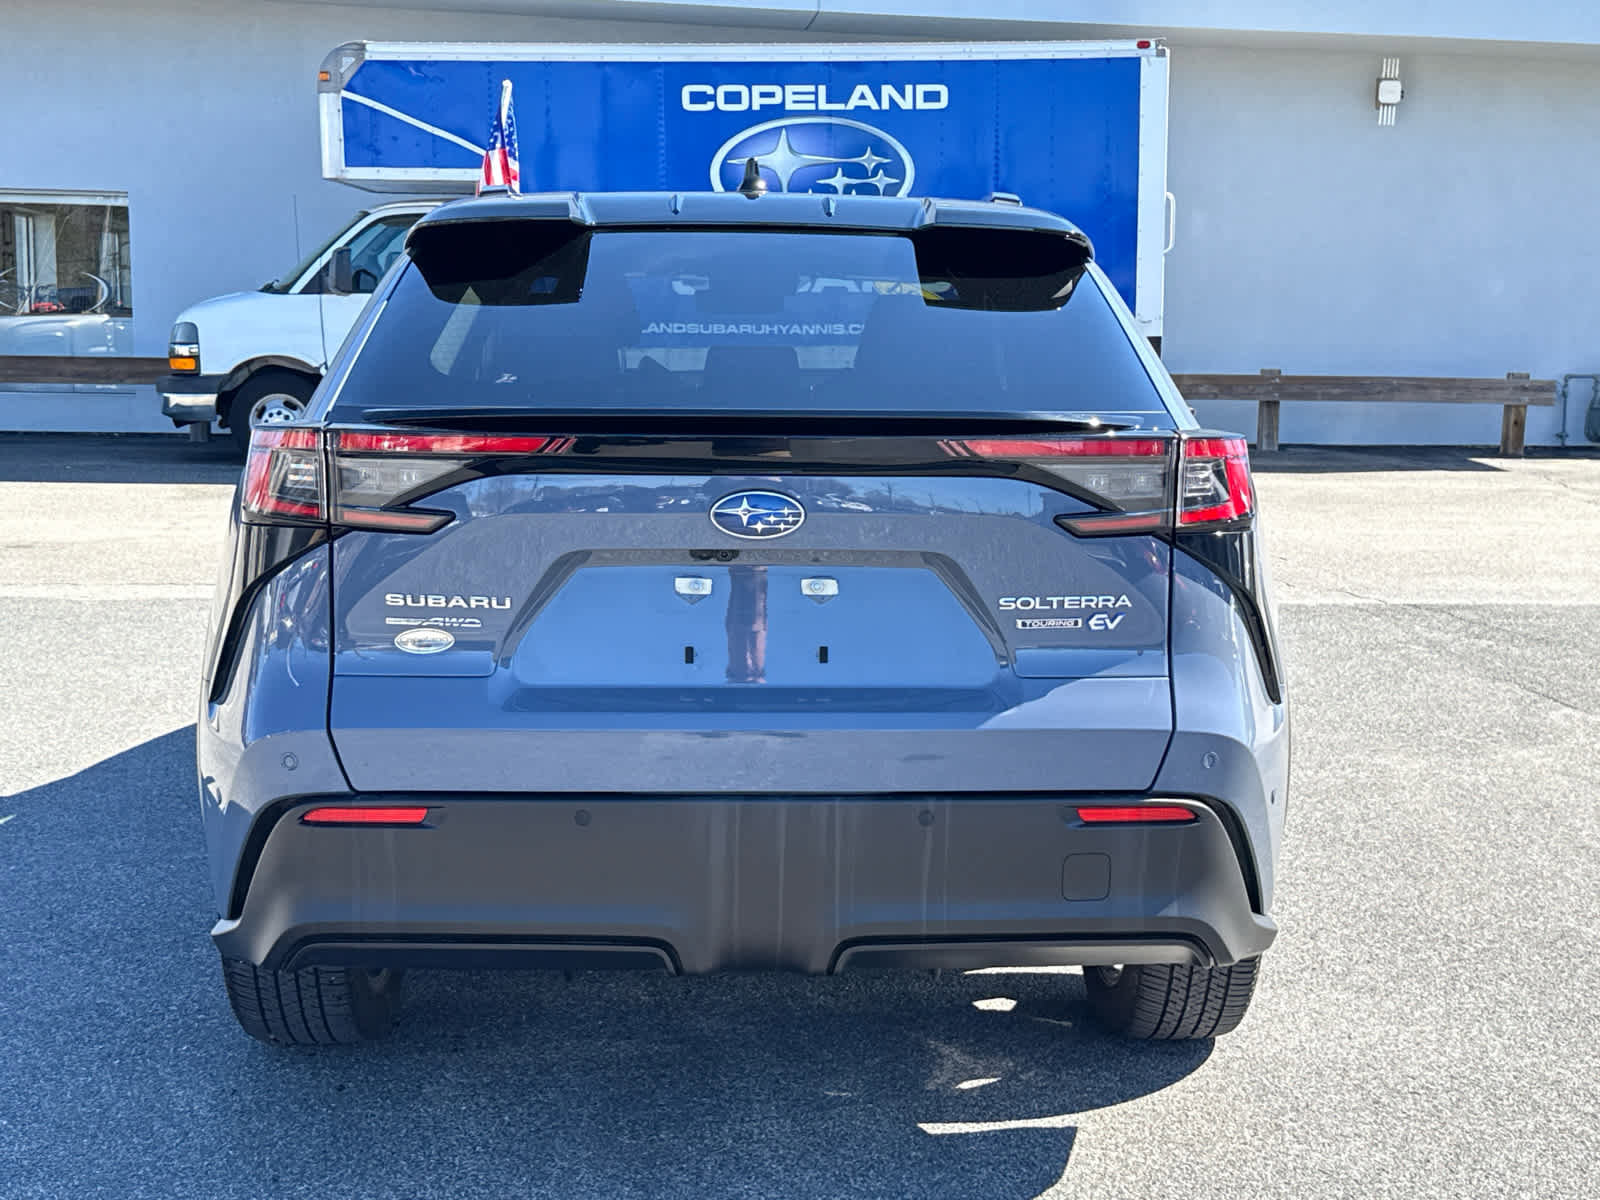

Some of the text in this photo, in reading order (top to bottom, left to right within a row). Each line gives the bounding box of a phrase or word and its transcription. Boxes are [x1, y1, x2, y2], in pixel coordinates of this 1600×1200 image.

[681, 84, 949, 111] COPELAND
[385, 593, 511, 609] SUBARU
[999, 594, 1132, 610] SOLTERRA
[1025, 619, 1075, 627] TOURING
[1089, 613, 1125, 630] EV
